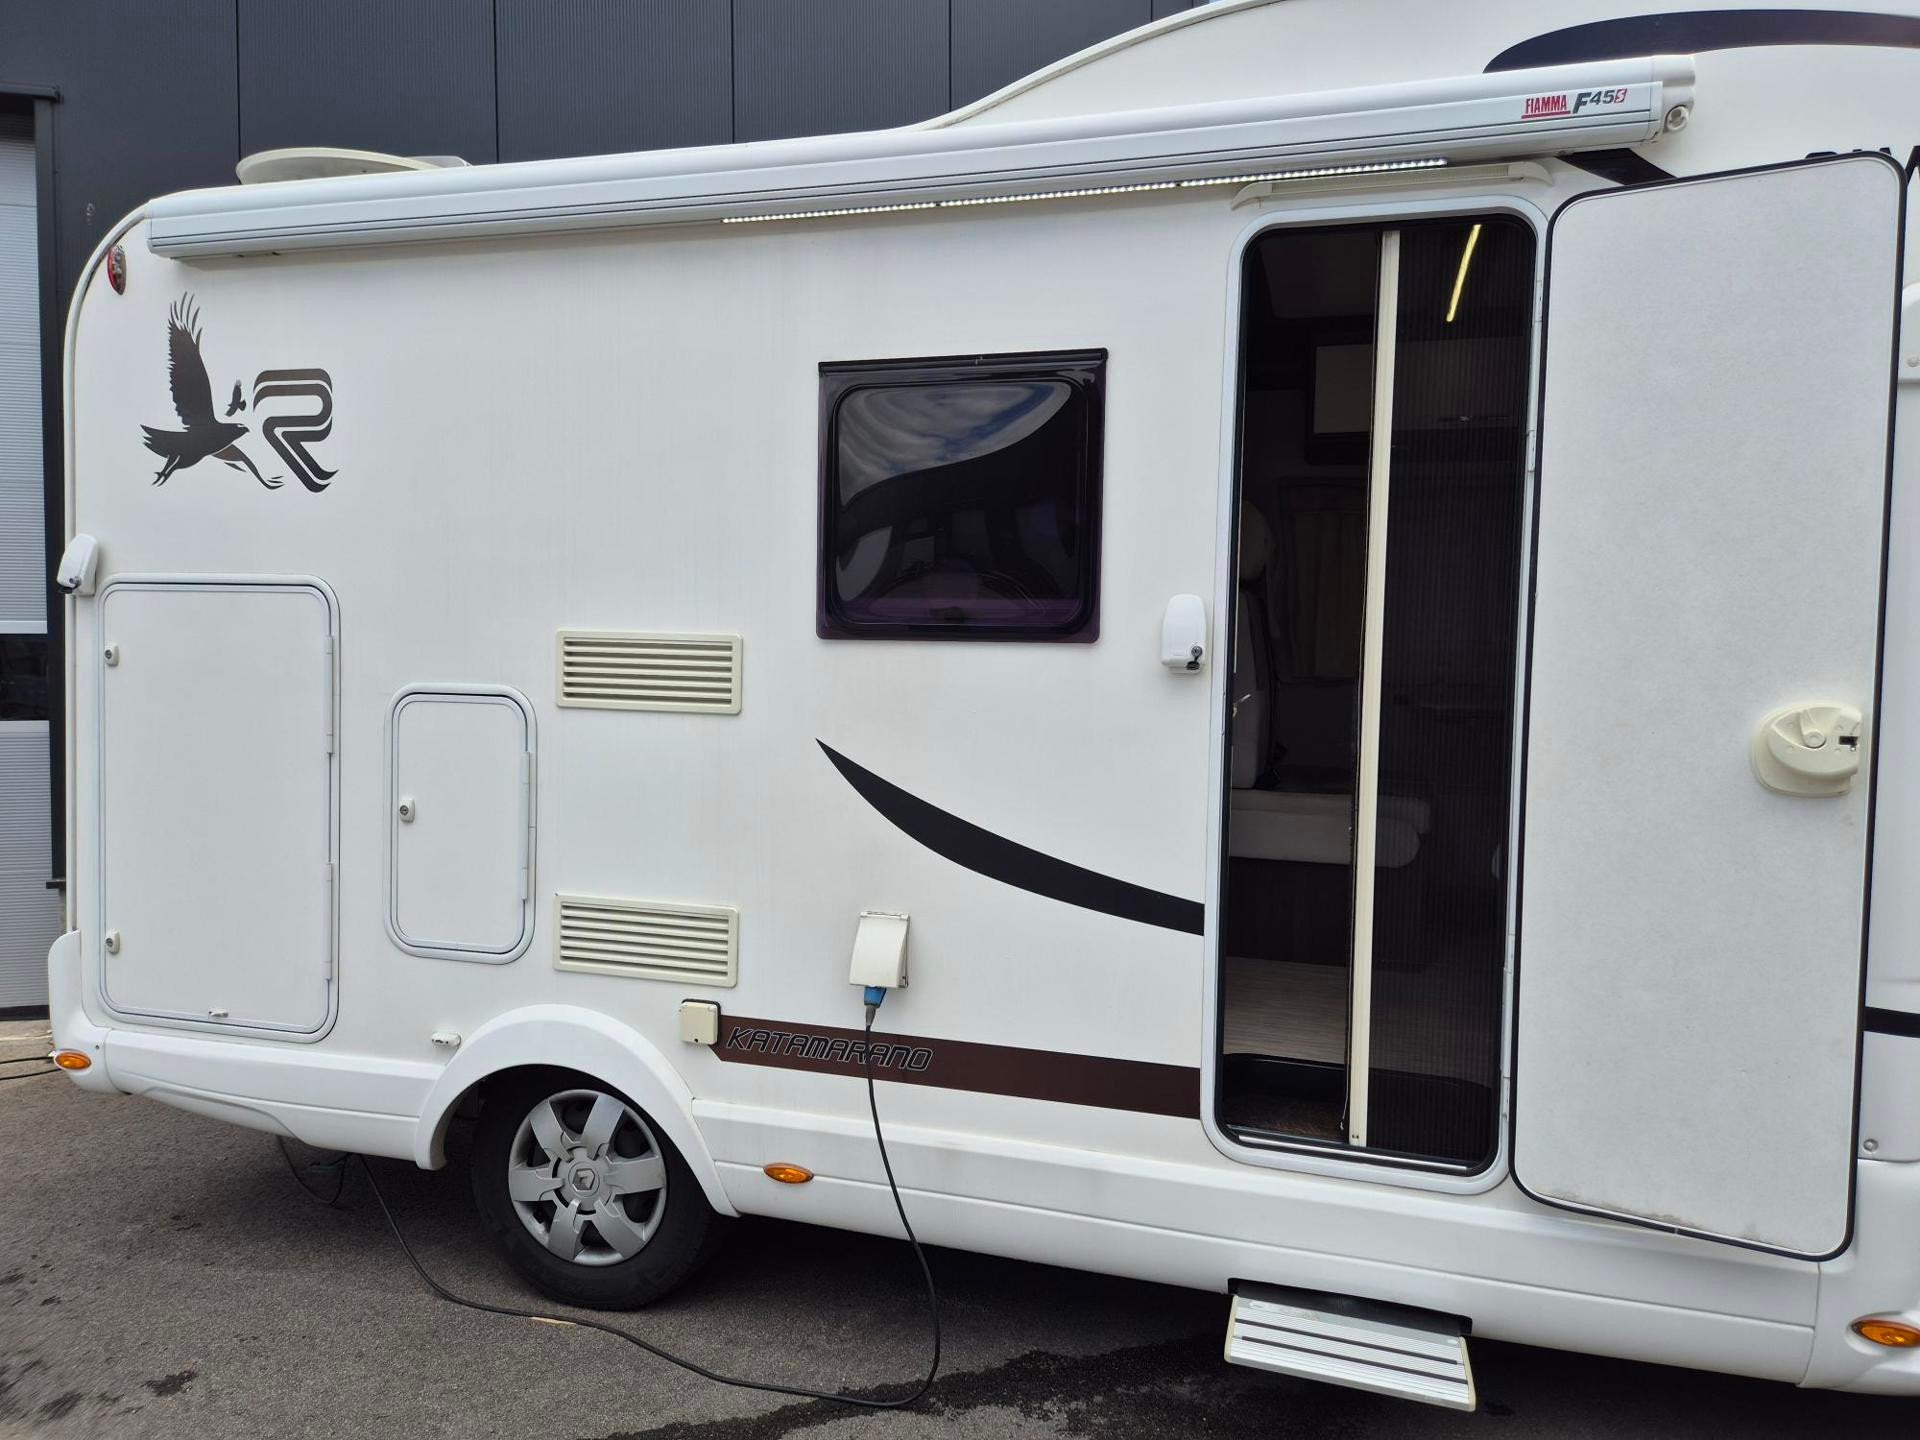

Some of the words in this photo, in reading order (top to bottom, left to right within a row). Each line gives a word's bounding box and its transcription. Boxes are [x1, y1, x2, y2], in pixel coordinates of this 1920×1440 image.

[1525, 94, 1568, 115] FIAMMA
[253, 368, 339, 493] R
[726, 1026, 934, 1072] KATAMARANO
